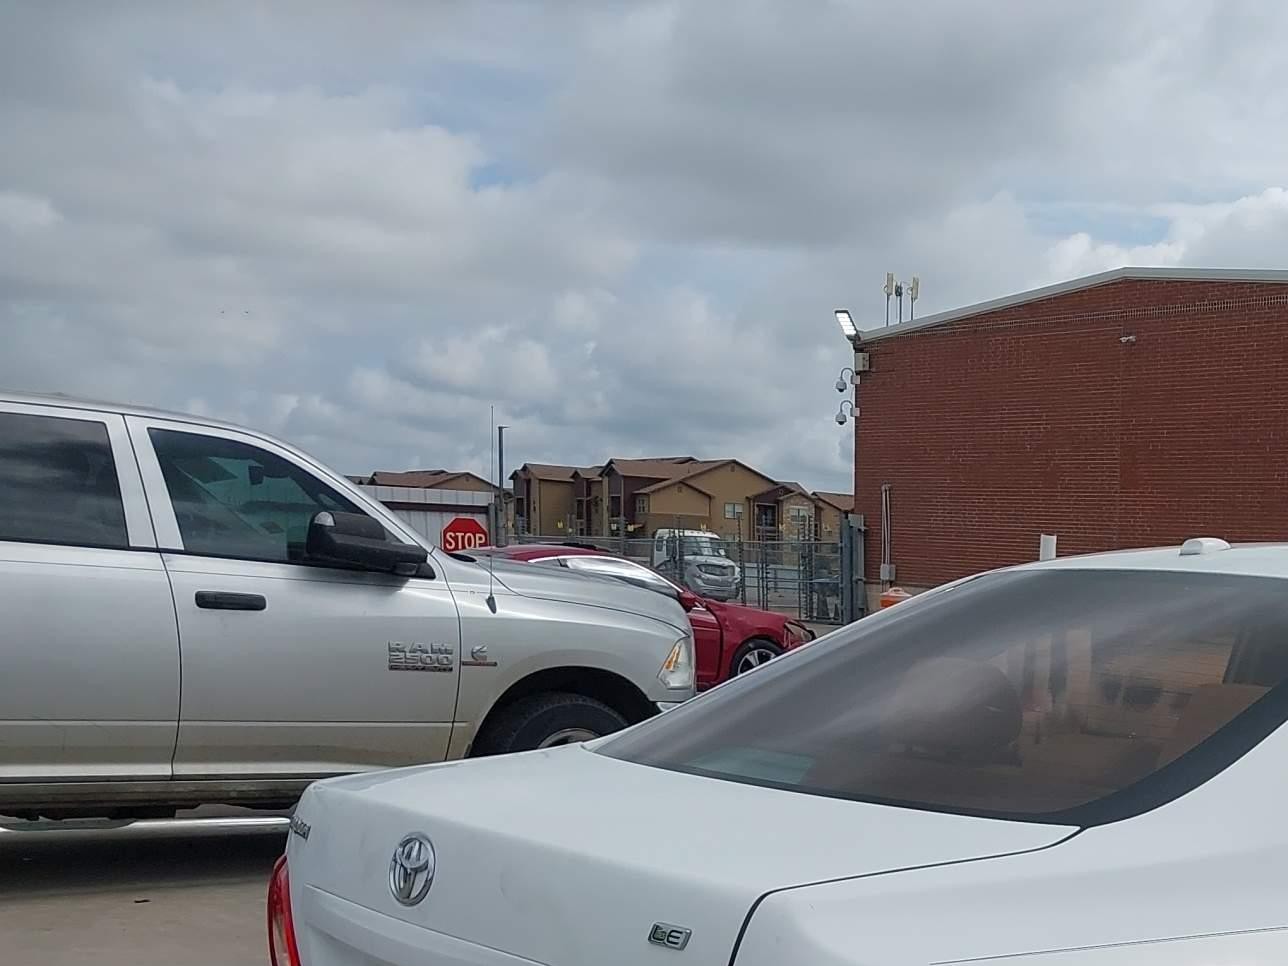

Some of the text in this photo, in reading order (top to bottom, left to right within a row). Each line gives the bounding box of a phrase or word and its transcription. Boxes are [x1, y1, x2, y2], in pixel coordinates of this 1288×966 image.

[445, 532, 485, 550] STOP
[388, 640, 453, 654] RAM
[388, 653, 453, 665] 2500
[652, 923, 685, 946] LE
